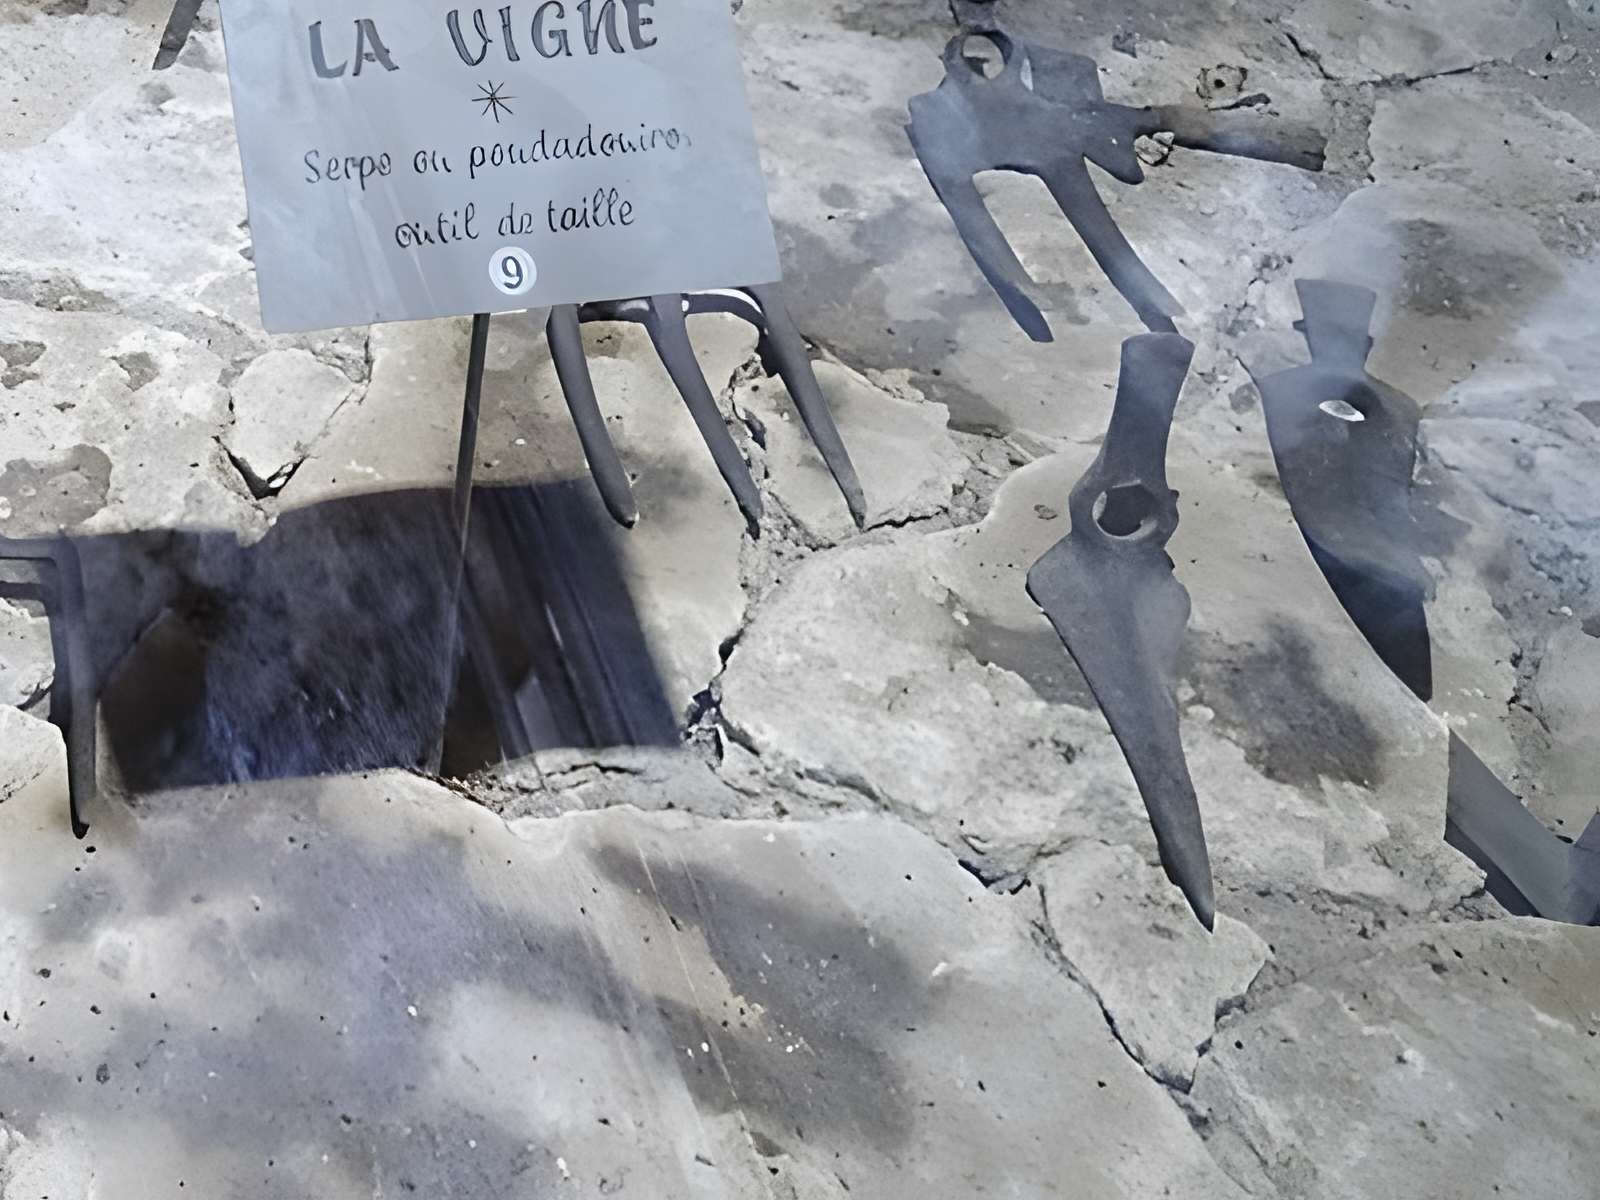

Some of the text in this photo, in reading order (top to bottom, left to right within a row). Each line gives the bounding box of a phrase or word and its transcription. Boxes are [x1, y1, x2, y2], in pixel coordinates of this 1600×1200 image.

[308, 18, 400, 79] LA
[413, 150, 452, 174] ou
[394, 201, 479, 249] outil
[547, 187, 634, 233] taille
[501, 255, 524, 290] 9
